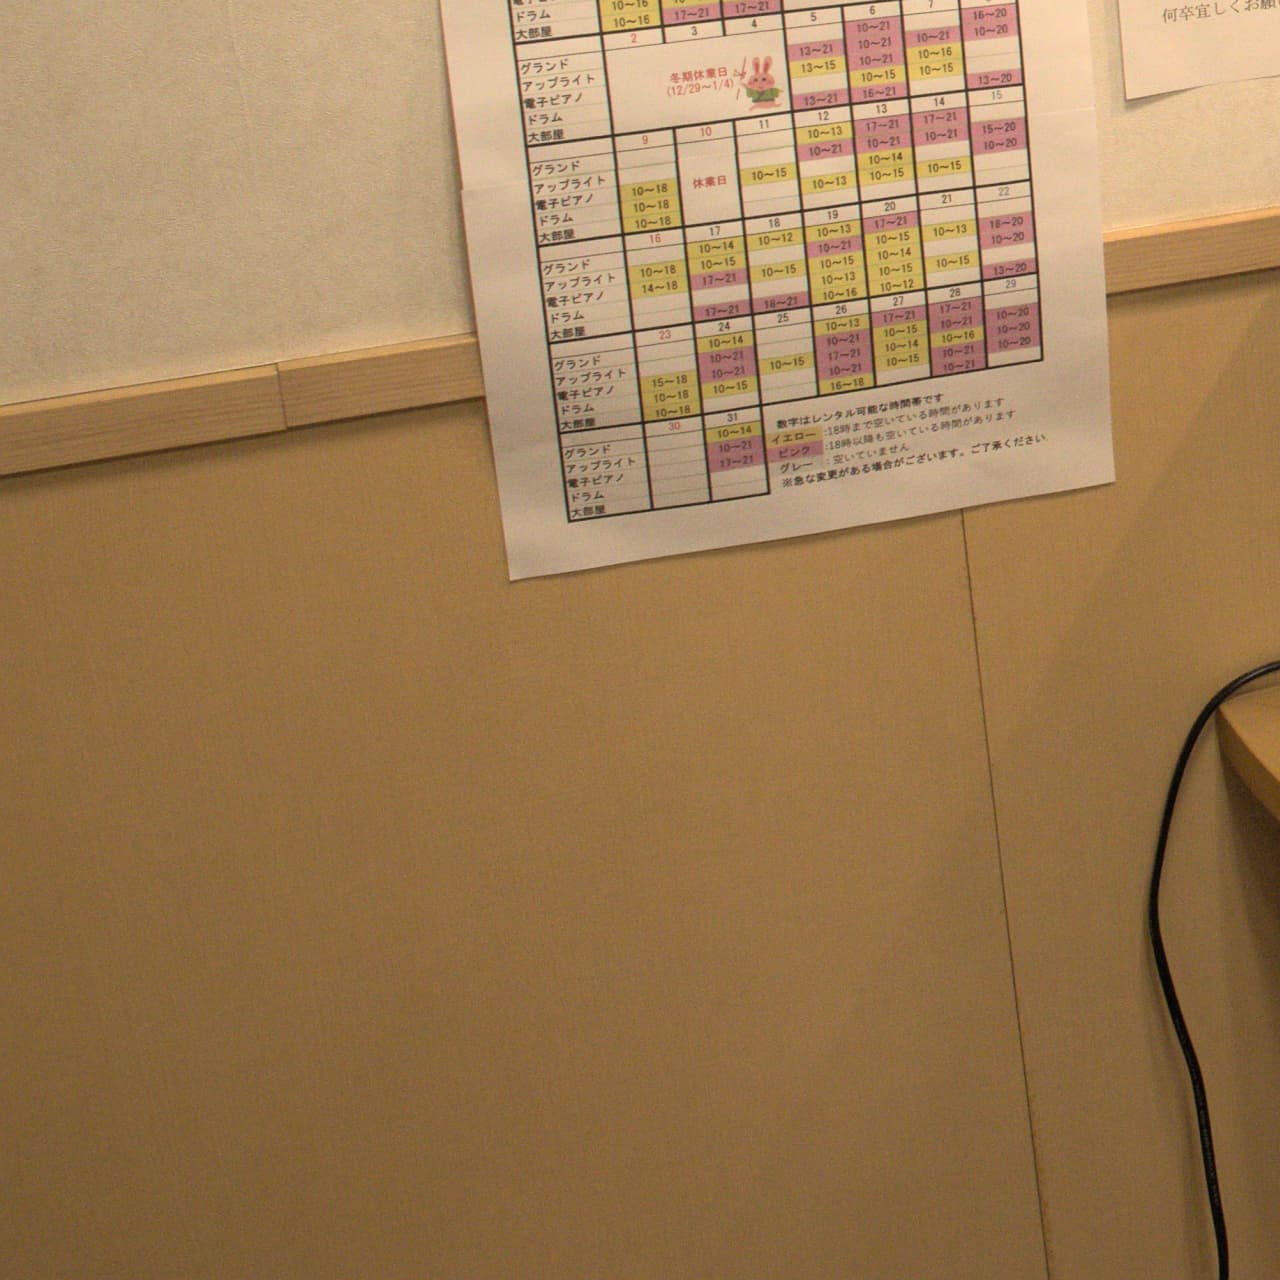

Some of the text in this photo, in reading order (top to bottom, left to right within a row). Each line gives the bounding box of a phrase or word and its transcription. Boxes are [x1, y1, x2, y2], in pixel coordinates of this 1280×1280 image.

[776, 394, 944, 429] 数字はレンタル可能な時間帯です
[771, 431, 816, 444] イエロー
[779, 446, 810, 458] ピンク
[780, 462, 814, 473] グレー
